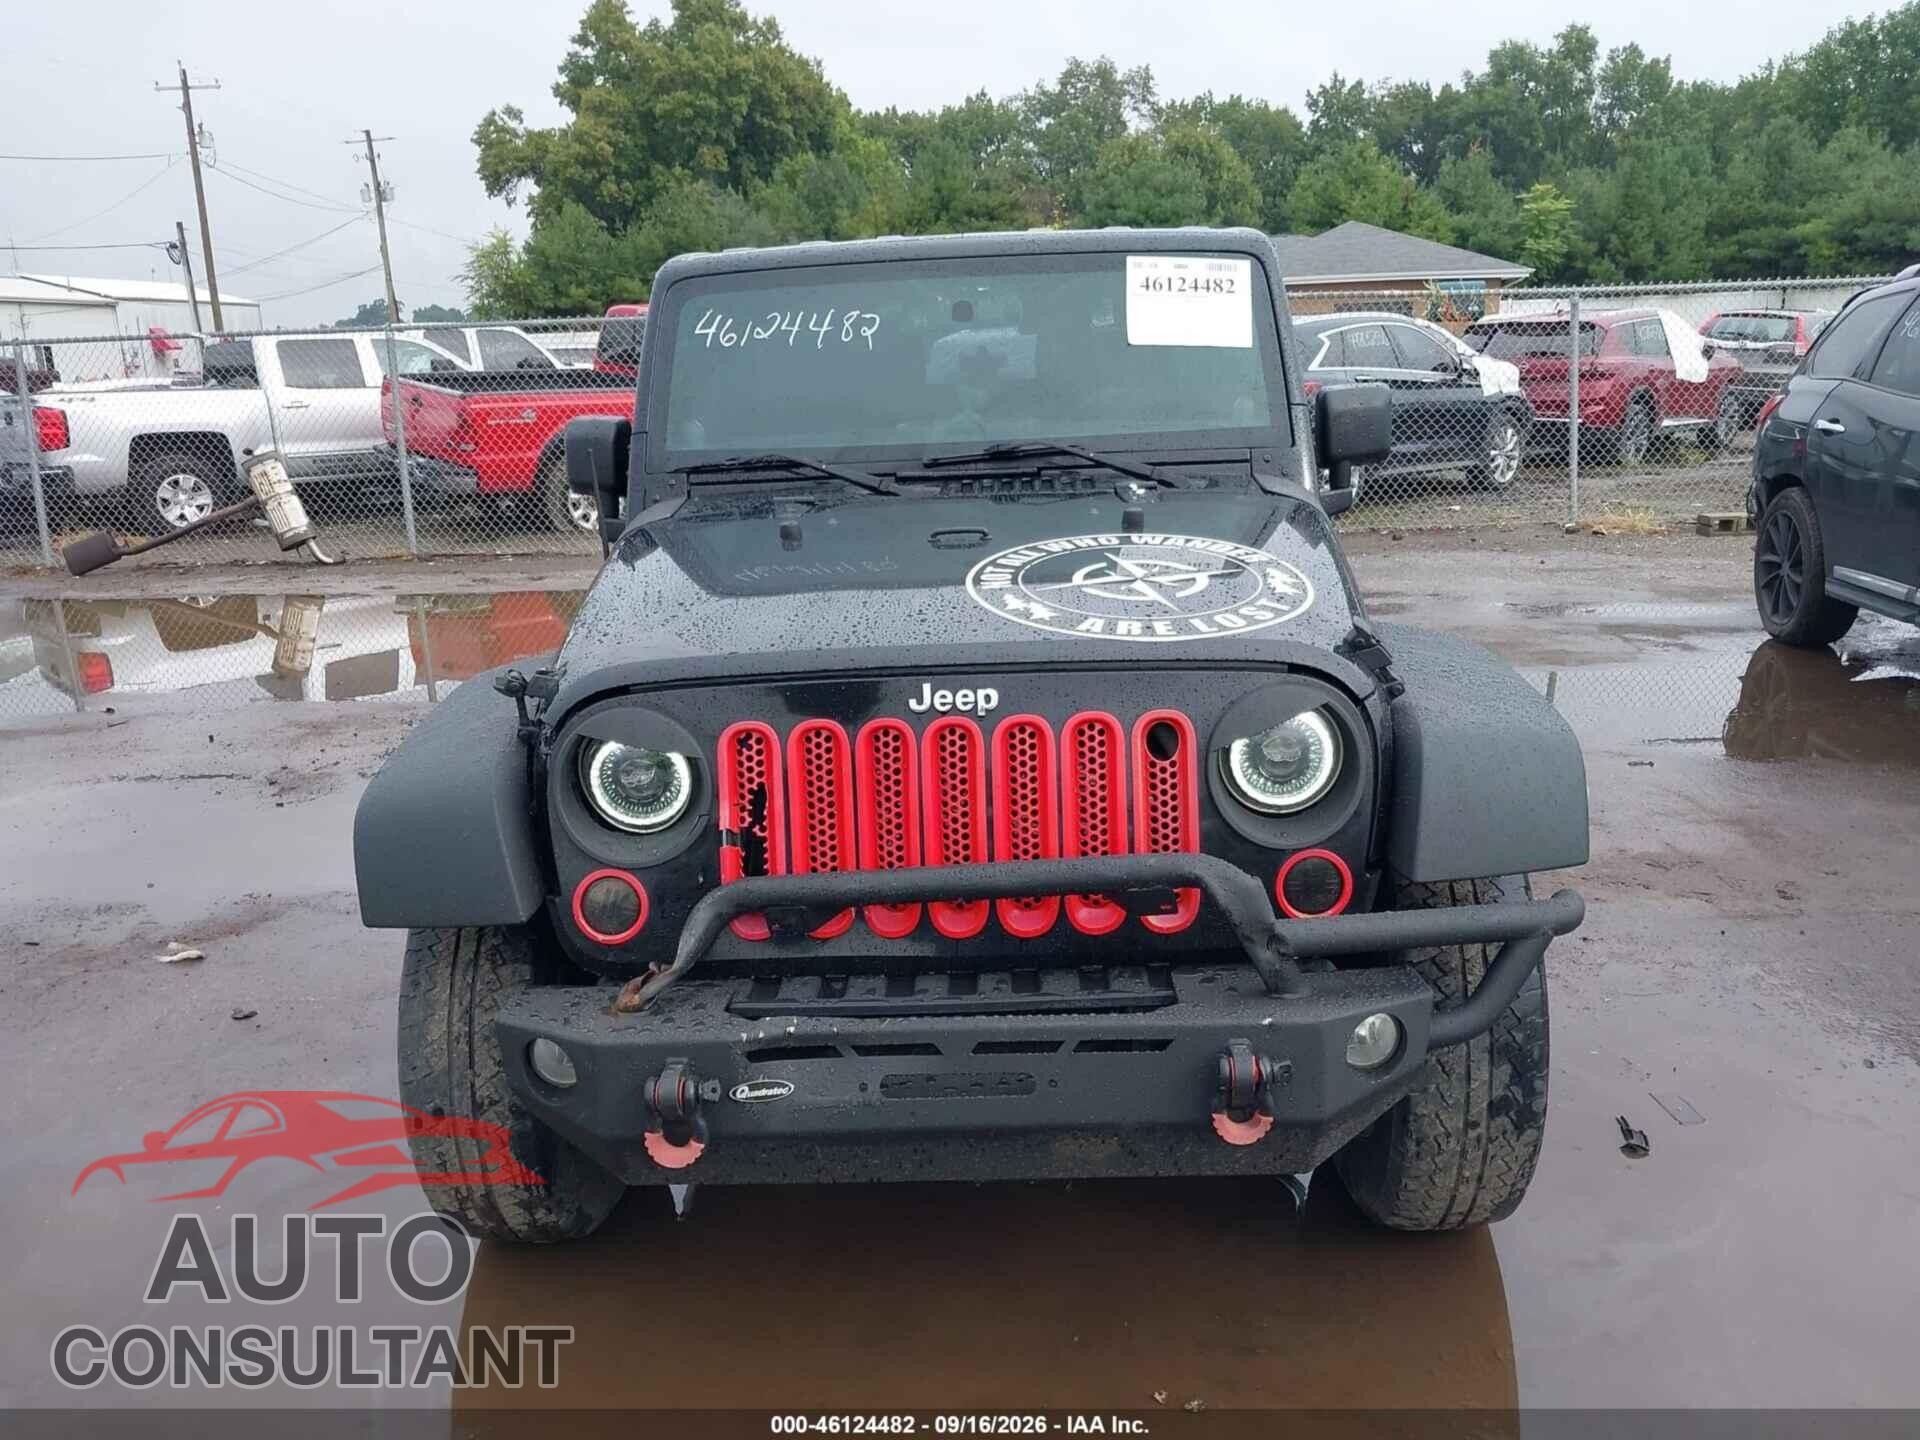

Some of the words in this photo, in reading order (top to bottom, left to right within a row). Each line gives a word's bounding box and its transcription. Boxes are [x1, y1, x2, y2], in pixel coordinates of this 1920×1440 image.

[1139, 276, 1236, 294] 46124482
[694, 307, 880, 351] 46124482
[1037, 535, 1121, 553] WHO
[1129, 534, 1270, 563] WANDER
[996, 549, 1047, 567] ALL
[979, 565, 1015, 589] NOT
[1075, 616, 1178, 636] ARE
[1188, 598, 1292, 633] LOST
[908, 682, 999, 716] Jeep
